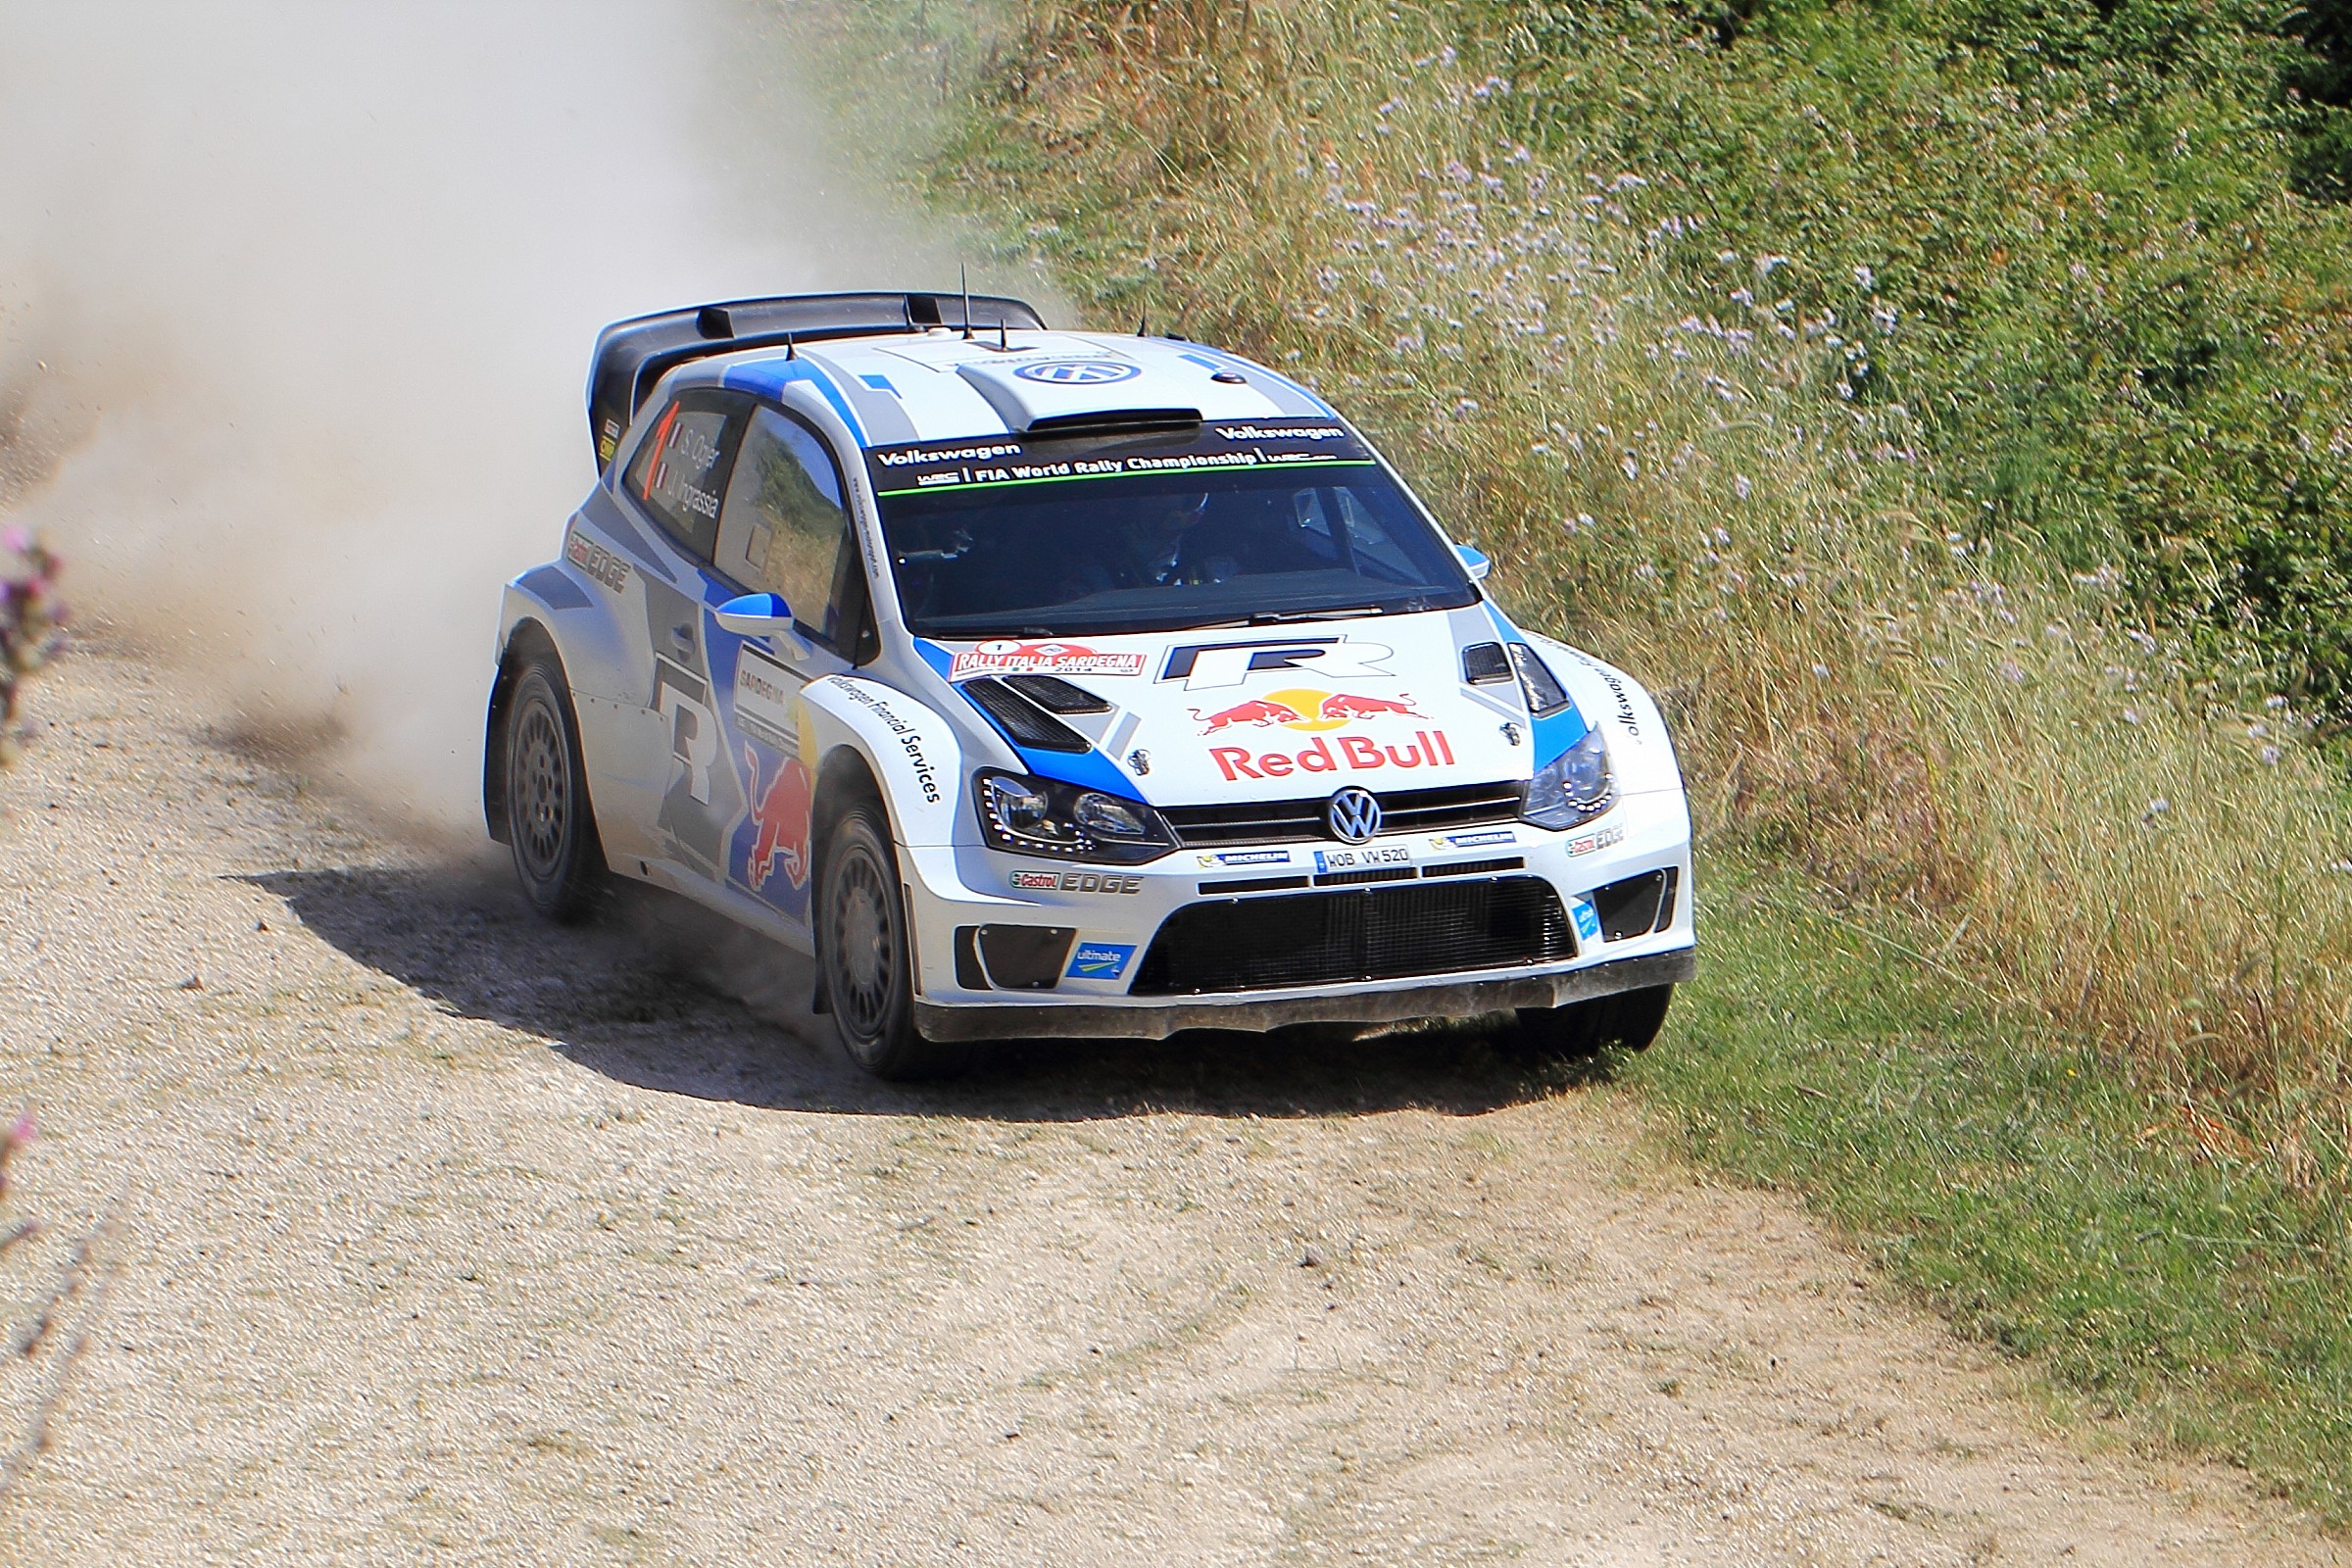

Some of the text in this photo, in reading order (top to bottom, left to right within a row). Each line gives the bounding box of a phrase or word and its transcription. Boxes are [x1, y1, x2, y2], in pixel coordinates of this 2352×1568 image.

[1215, 425, 1345, 440] Volkswagen
[878, 443, 1021, 466] Volkswagen
[974, 468, 1009, 482] FIA
[1011, 464, 1071, 478] World
[1074, 460, 1123, 472] Rally
[1127, 452, 1257, 469] Championship
[587, 545, 632, 595] EDGE
[956, 654, 1138, 671] RALLY ITALIA SARDEGNA
[866, 702, 915, 735] Financial
[901, 735, 940, 804] Services
[1208, 730, 1455, 781] Red Bull
[1225, 851, 1289, 861] MICHELIN
[1327, 849, 1408, 867] WOB VW 520
[1020, 873, 1145, 894] Castrol EDGE
[1077, 950, 1121, 961] ultimate
